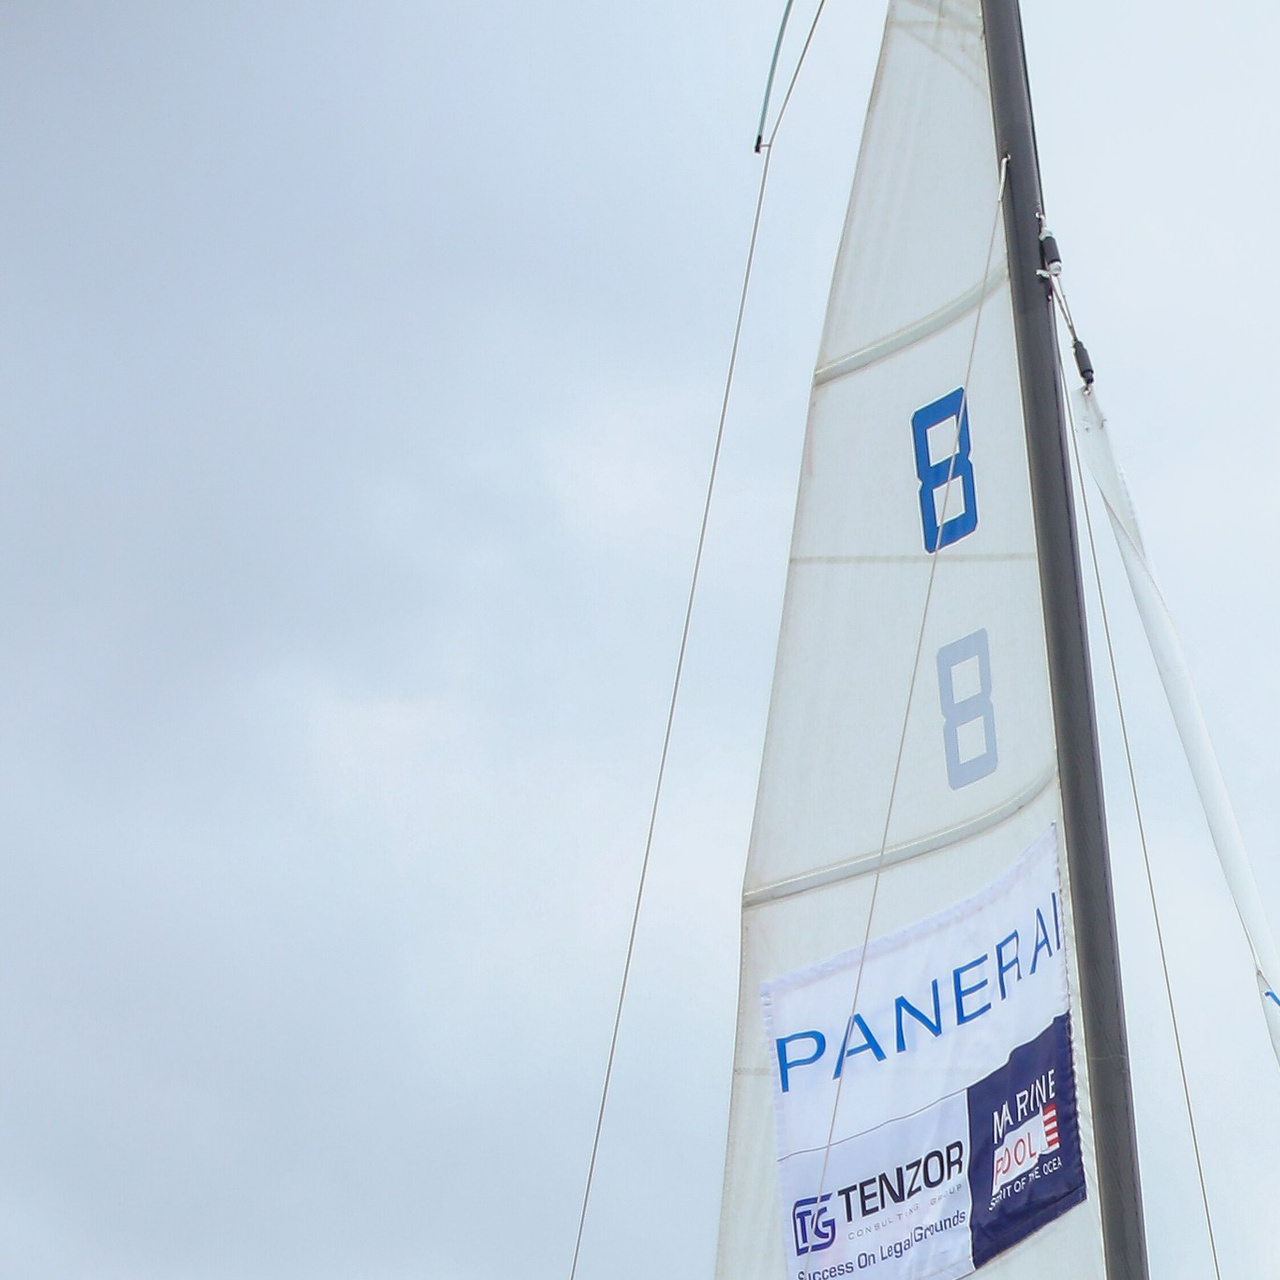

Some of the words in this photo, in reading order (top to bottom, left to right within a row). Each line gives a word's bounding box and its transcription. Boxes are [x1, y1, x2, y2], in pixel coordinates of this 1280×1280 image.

[911, 386, 978, 554] 8
[936, 627, 999, 791] 8
[775, 891, 1062, 1094] PANERAI
[993, 1068, 1056, 1145] MARINE
[837, 1140, 964, 1223] TENZOR
[857, 1252, 876, 1270] On
[879, 1231, 914, 1259] Legal
[912, 1210, 967, 1243] Grounds
